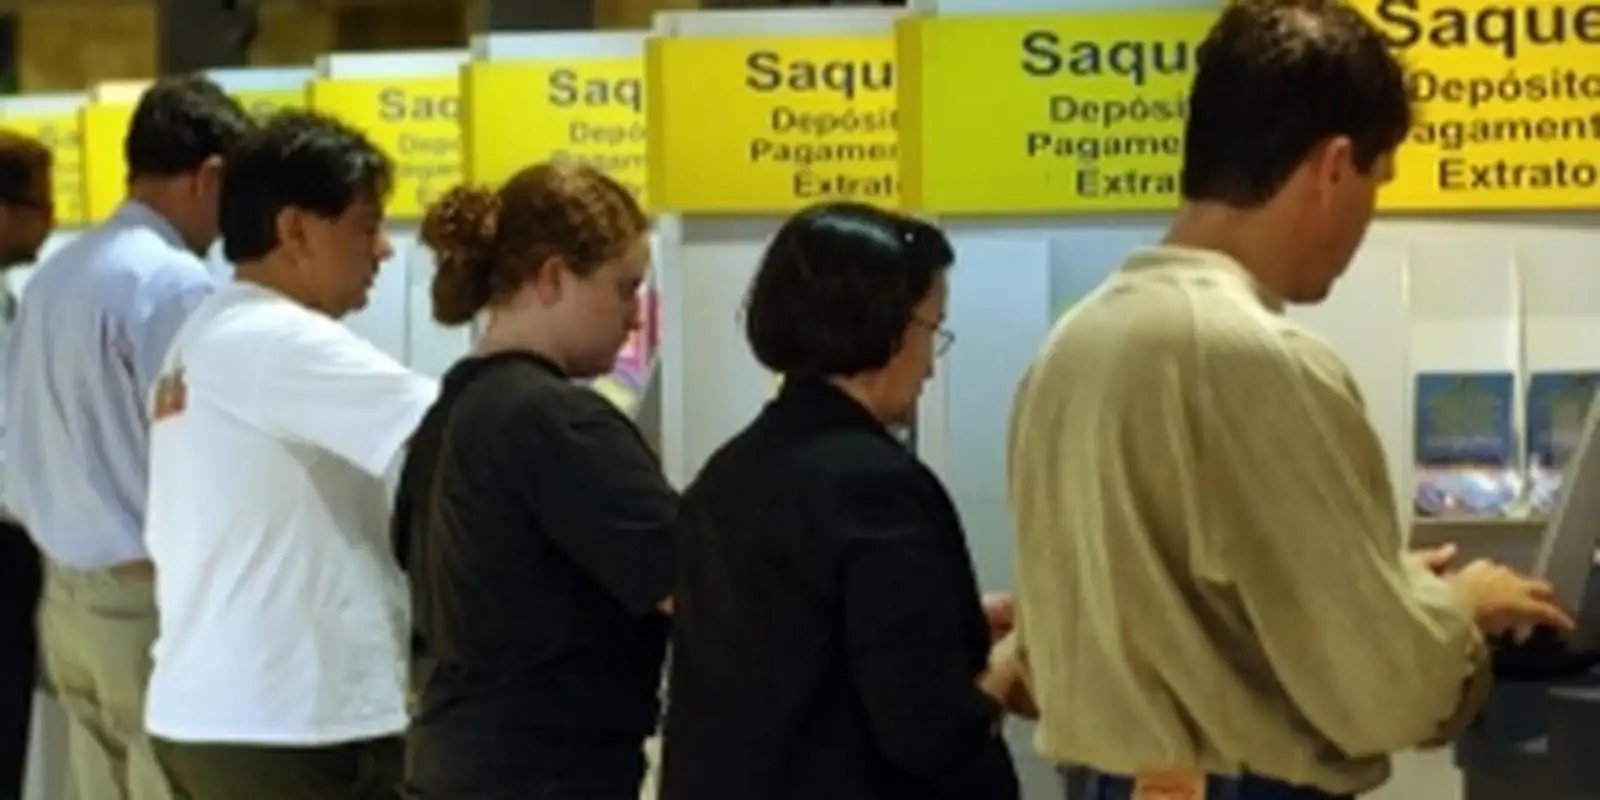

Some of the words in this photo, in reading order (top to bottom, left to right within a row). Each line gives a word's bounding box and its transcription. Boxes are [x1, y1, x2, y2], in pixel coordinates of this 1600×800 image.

[1377, 0, 1600, 59] Saque
[746, 50, 893, 100] Saqu
[1022, 30, 1200, 86] Saqu
[548, 67, 642, 113] Saq
[1409, 68, 1600, 108] Depósito
[1050, 89, 1185, 128] Depósi
[1027, 132, 1181, 160] Pagame
[1409, 112, 1600, 151] agament
[793, 173, 902, 198] Extrat
[1076, 168, 1176, 197] Extra
[1438, 158, 1597, 192] Extrato
